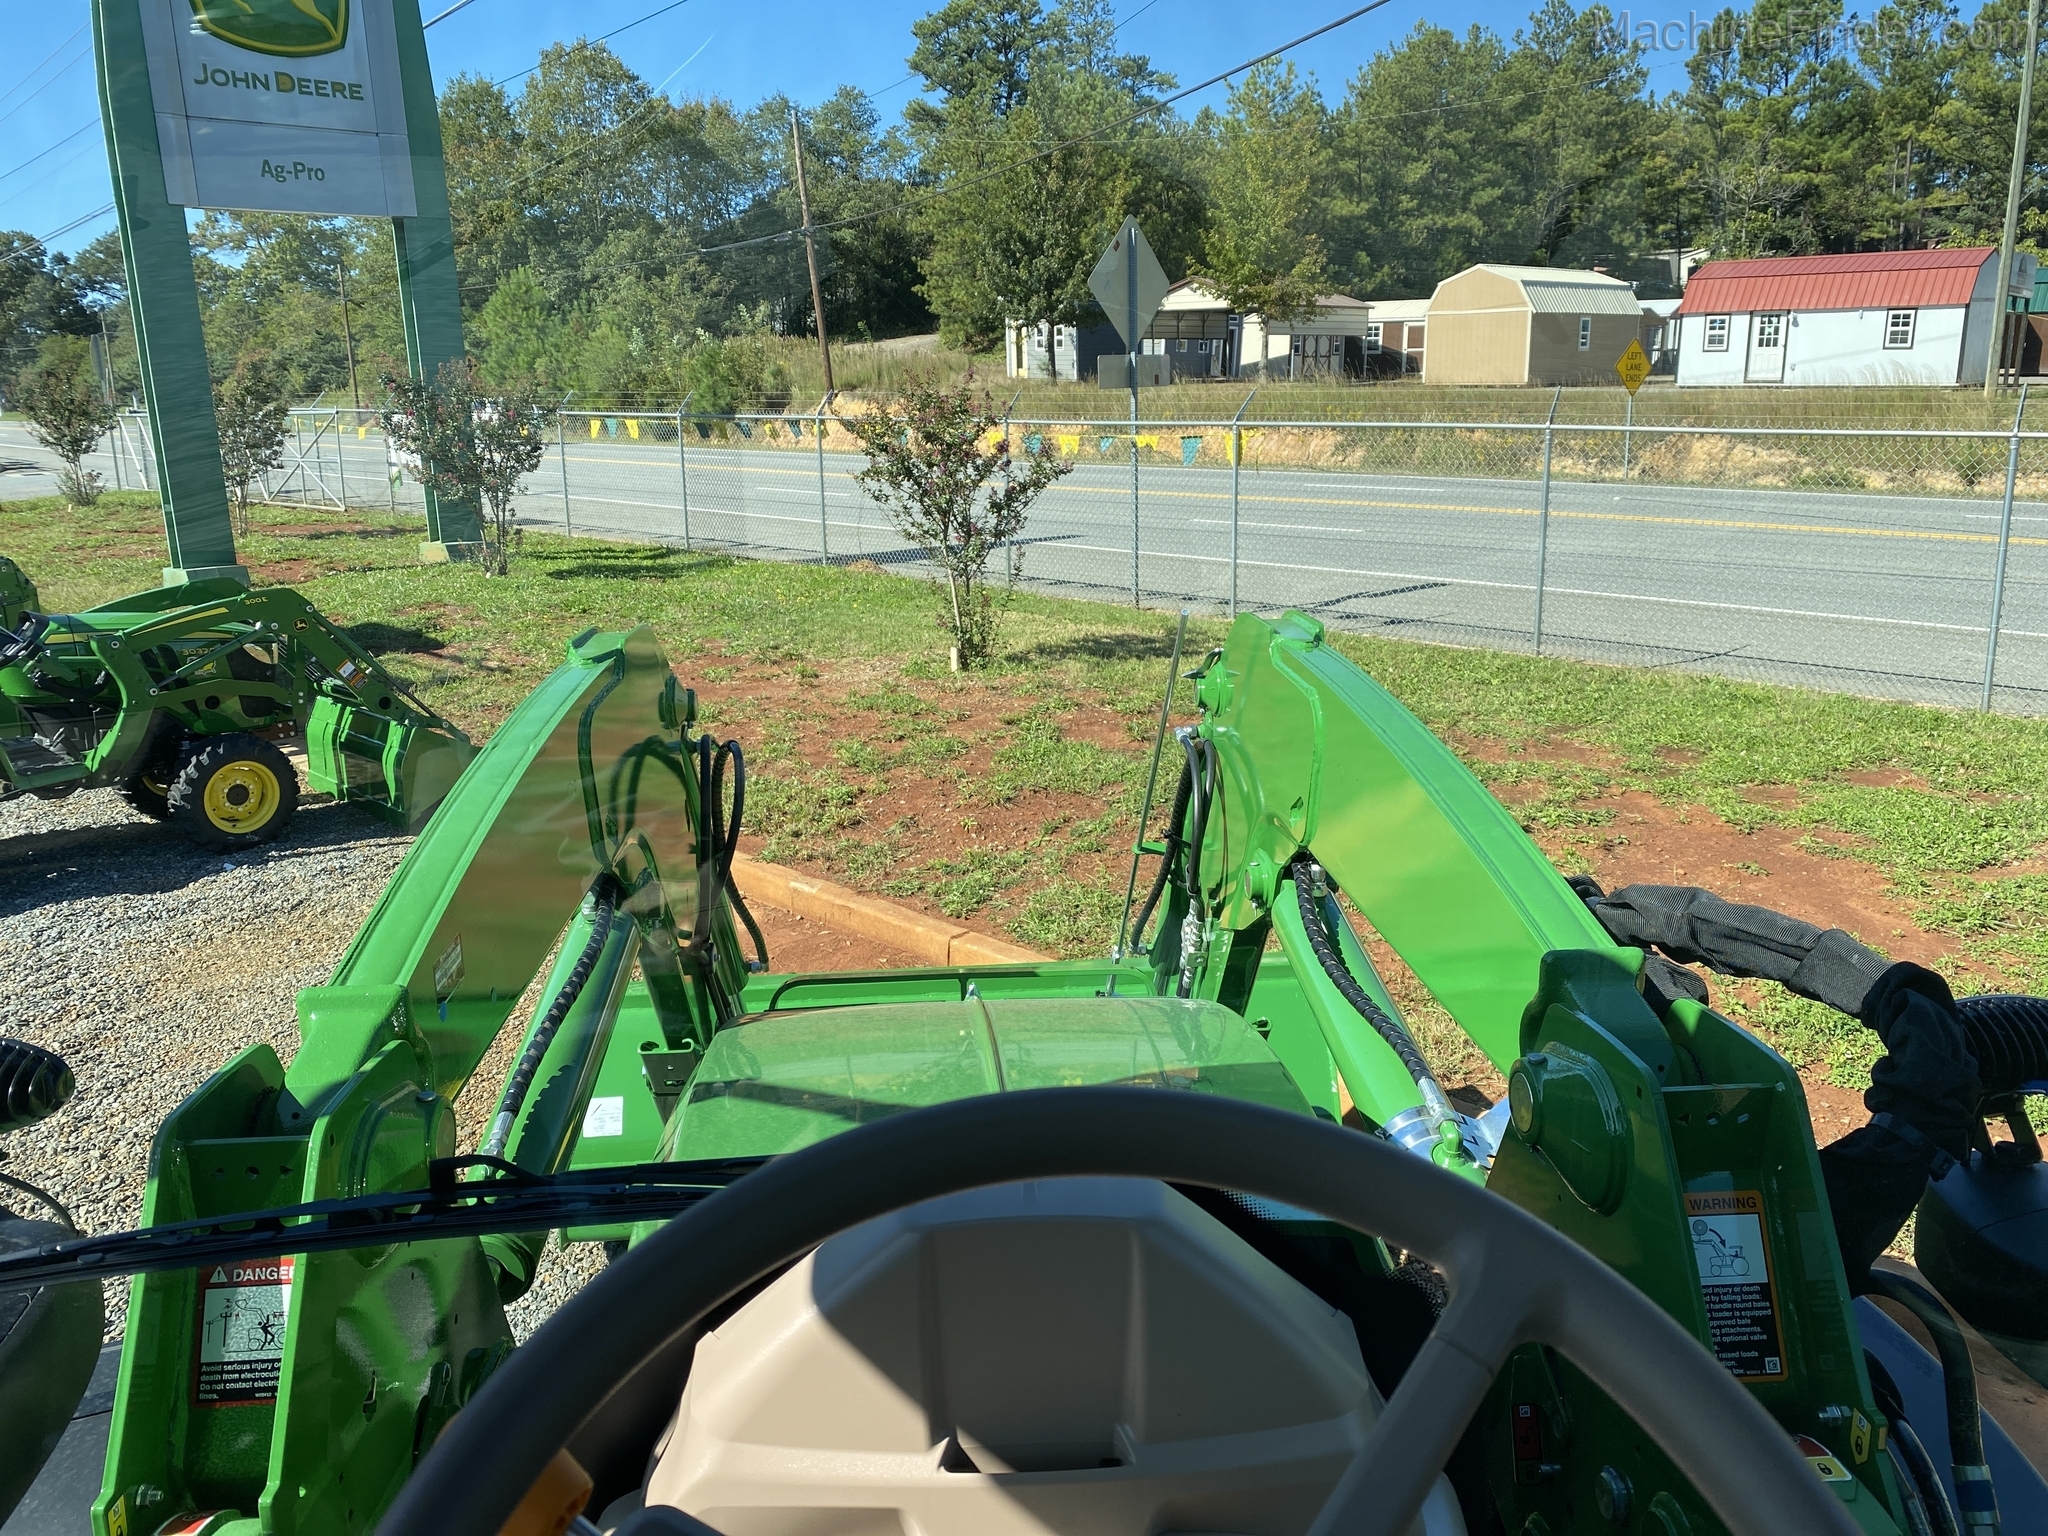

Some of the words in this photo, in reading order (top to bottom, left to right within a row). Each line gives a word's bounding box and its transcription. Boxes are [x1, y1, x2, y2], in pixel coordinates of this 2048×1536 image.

[193, 62, 270, 92] JOHN
[273, 71, 364, 101] DEERE
[260, 159, 326, 183] Ag-Pro
[1627, 352, 1642, 360] LEFT
[1626, 363, 1642, 371] LANE
[1626, 374, 1641, 382] ENDS
[1689, 1197, 1757, 1210] WARNING
[1713, 1286, 1732, 1294] injury
[1711, 1294, 1719, 1302] by
[1720, 1294, 1741, 1302] falling
[1741, 1309, 1772, 1317] equipped
[1709, 1318, 1736, 1327] pproved
[1721, 1326, 1763, 1334] attachments.
[1722, 1334, 1749, 1343] optional
[201, 1364, 222, 1372] Avoid
[223, 1363, 250, 1371] serious
[251, 1361, 273, 1370] injury
[200, 1373, 221, 1381] death
[200, 1383, 211, 1391] Do
[211, 1382, 224, 1390] not
[225, 1381, 253, 1389] contact
